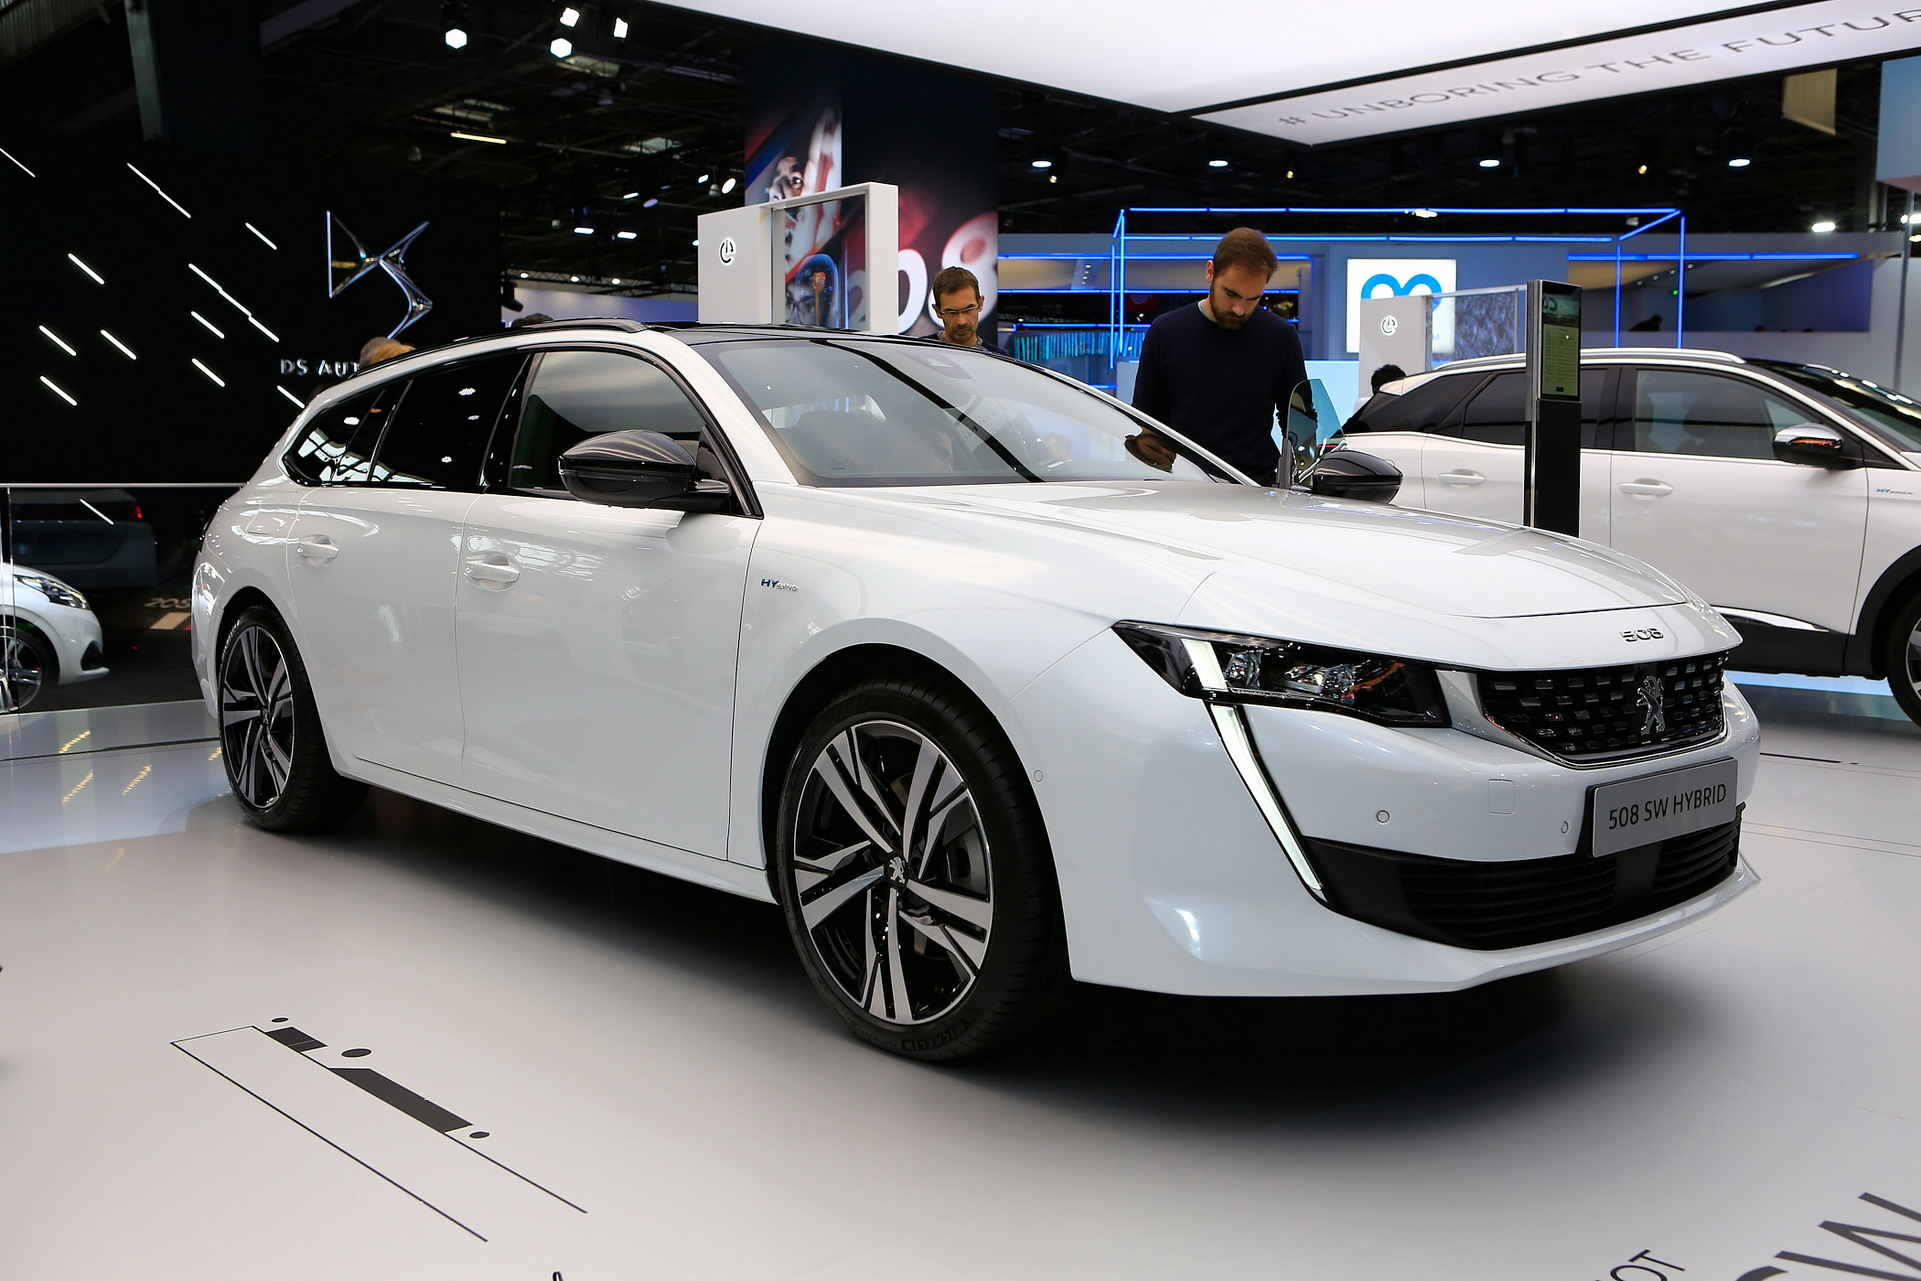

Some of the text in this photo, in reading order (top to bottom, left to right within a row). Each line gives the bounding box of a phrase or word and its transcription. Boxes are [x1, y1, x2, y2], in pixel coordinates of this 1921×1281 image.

[1586, 48, 1713, 75] THE
[280, 358, 308, 375] DS
[1620, 627, 1664, 642] 508
[1609, 783, 1726, 829] 508 SW HYBRID
[902, 1019, 968, 1051] MICHELIN
